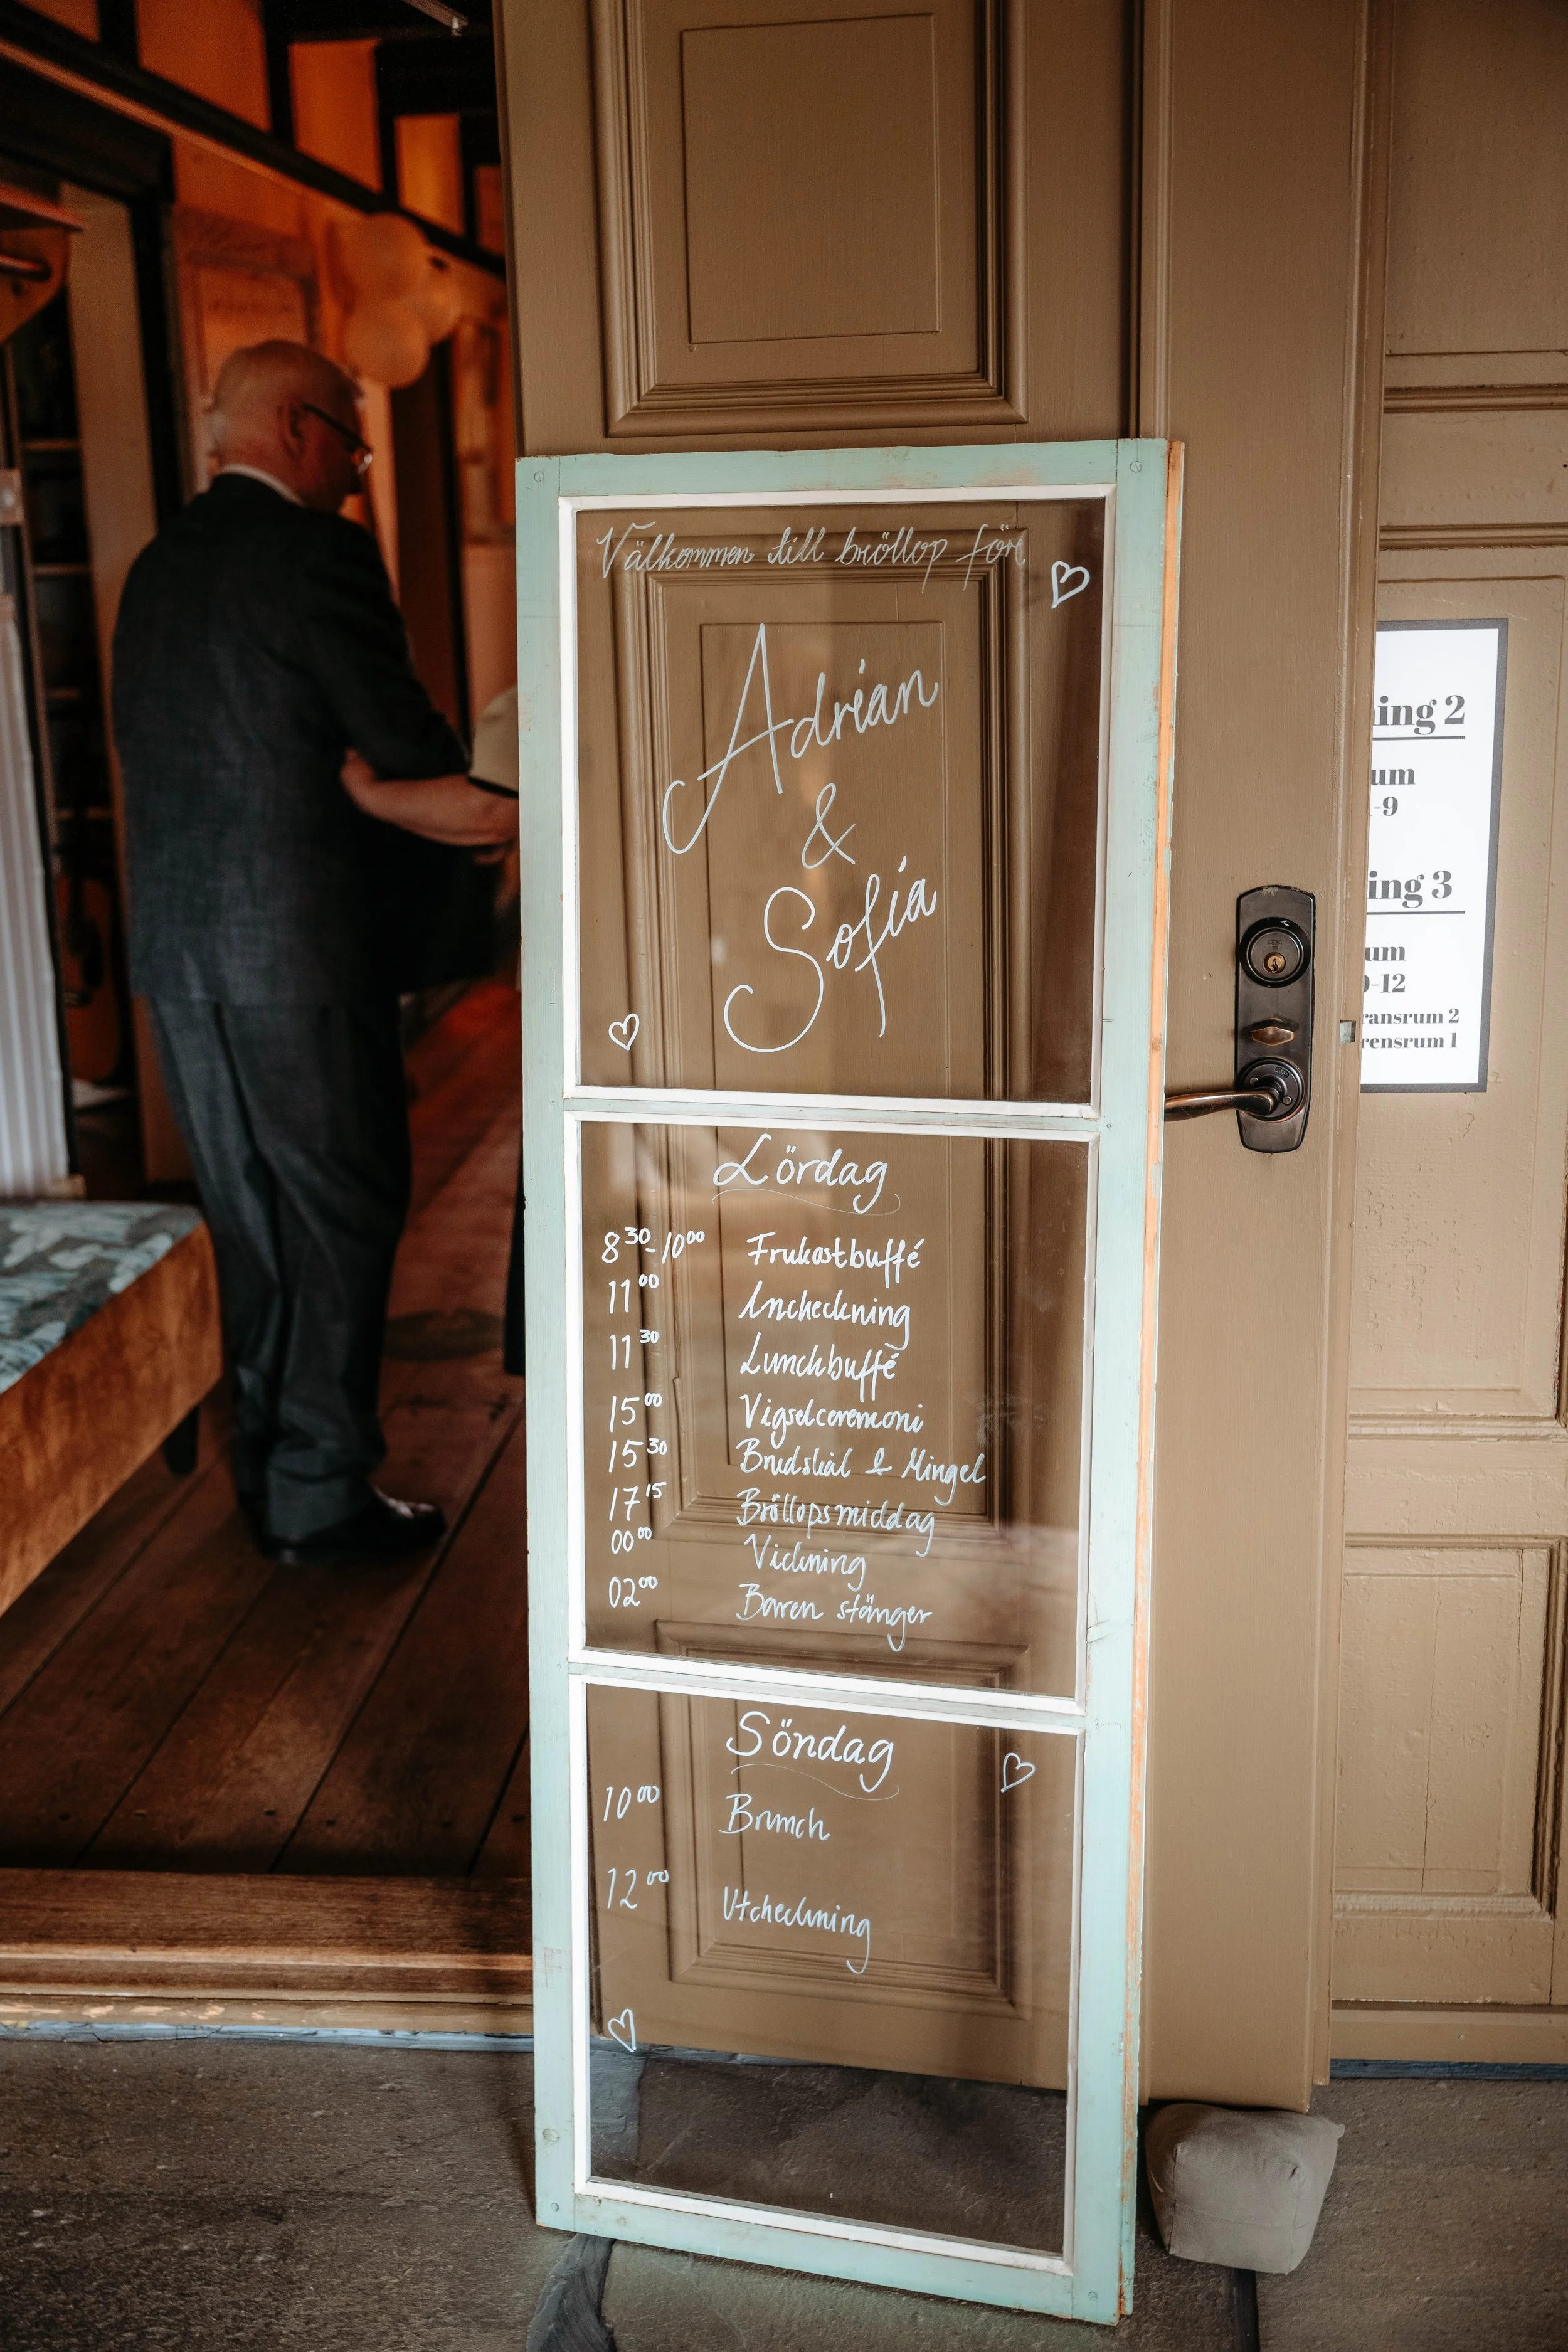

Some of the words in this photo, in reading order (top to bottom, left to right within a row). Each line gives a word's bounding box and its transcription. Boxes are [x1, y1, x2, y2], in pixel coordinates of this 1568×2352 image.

[768, 527, 825, 564] till
[834, 526, 948, 594] bröllop
[956, 523, 1026, 591] för
[663, 623, 938, 854] Adrian
[1373, 696, 1438, 735] ing
[1444, 695, 1465, 724] 2
[802, 783, 856, 869] &
[1431, 870, 1453, 899] 3
[724, 856, 937, 1052] Sofia
[1448, 1008, 1459, 1024] 2
[1449, 1032, 1458, 1048] 1
[712, 1133, 889, 1214] Lördag
[746, 1232, 925, 1289] Frukostbuffé
[738, 1280, 911, 1351] Incheckning
[739, 1332, 899, 1402] Lunchbuffé
[739, 1392, 924, 1449] Vigselceremoni
[865, 1447, 892, 1476] &
[901, 1447, 986, 1506] Mingel
[736, 1488, 935, 1557] Bröllopsmiddag
[744, 1534, 866, 1591] Vickning
[736, 1583, 824, 1621] Baren
[837, 1594, 933, 1652] stänger
[726, 1711, 895, 1793] Söndag
[718, 1793, 830, 1841] Brunch
[723, 1886, 871, 1974] Utcheckning
